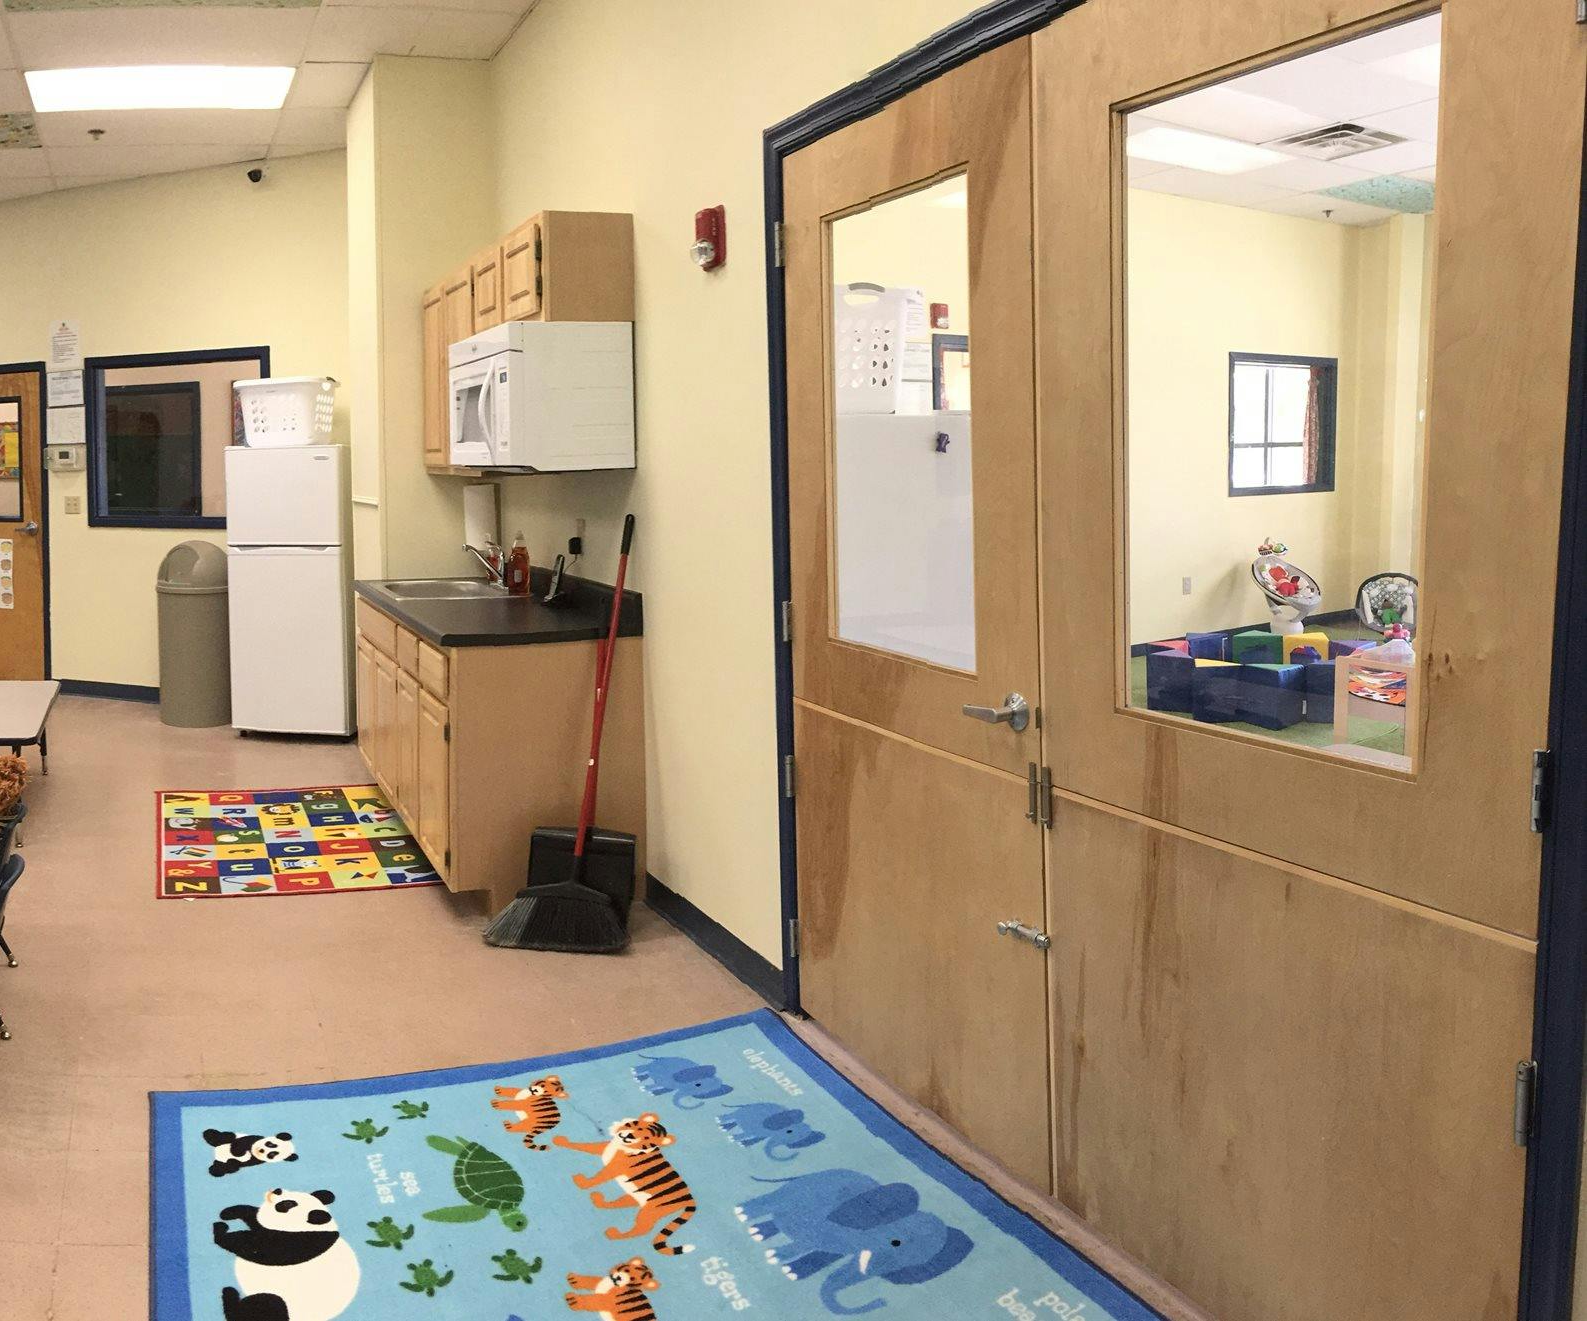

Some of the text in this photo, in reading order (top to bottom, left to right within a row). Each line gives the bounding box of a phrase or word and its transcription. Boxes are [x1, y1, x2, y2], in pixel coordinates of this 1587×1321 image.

[742, 1047, 804, 1097] elephants
[366, 1153, 399, 1204] turtles
[399, 1171, 421, 1197] sea
[700, 1256, 751, 1311] tigers
